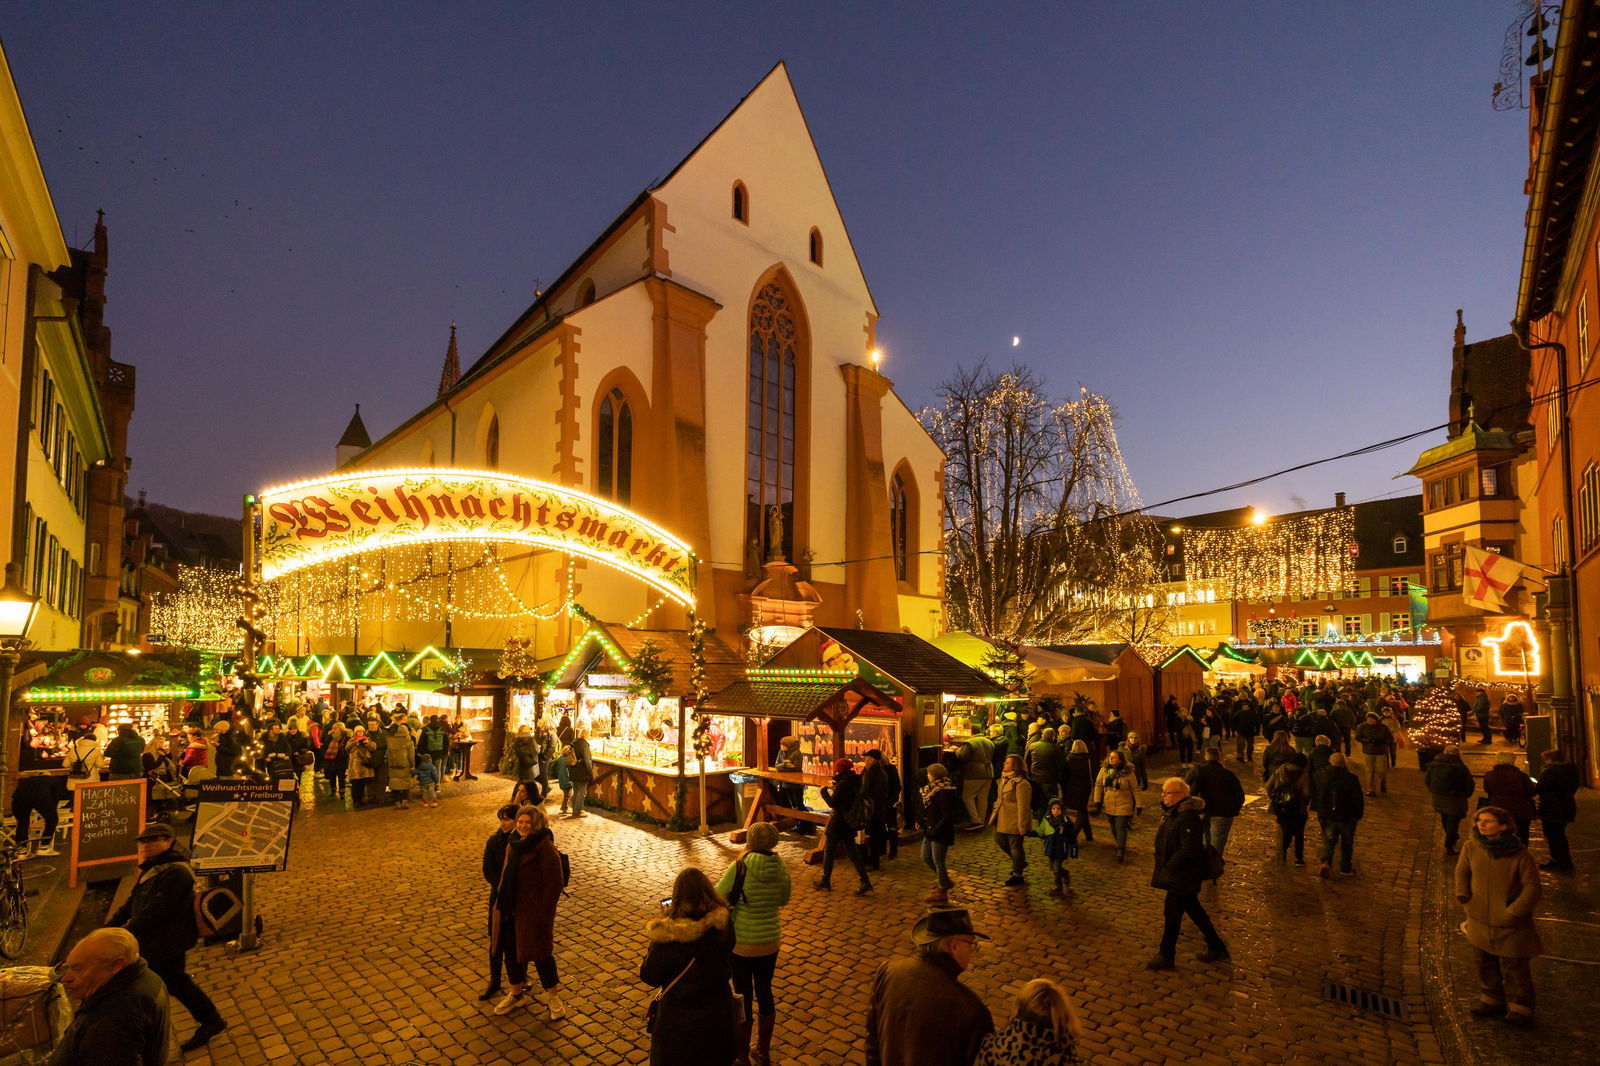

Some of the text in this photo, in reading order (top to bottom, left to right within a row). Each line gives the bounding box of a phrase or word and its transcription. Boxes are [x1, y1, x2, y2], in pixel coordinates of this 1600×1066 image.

[269, 485, 681, 573] Weihnachtsmarkt
[202, 784, 273, 792] Weihnachtsmarkt
[250, 791, 283, 799] Freiburg
[84, 821, 98, 829] ab
[82, 825, 128, 843] geöffnet
